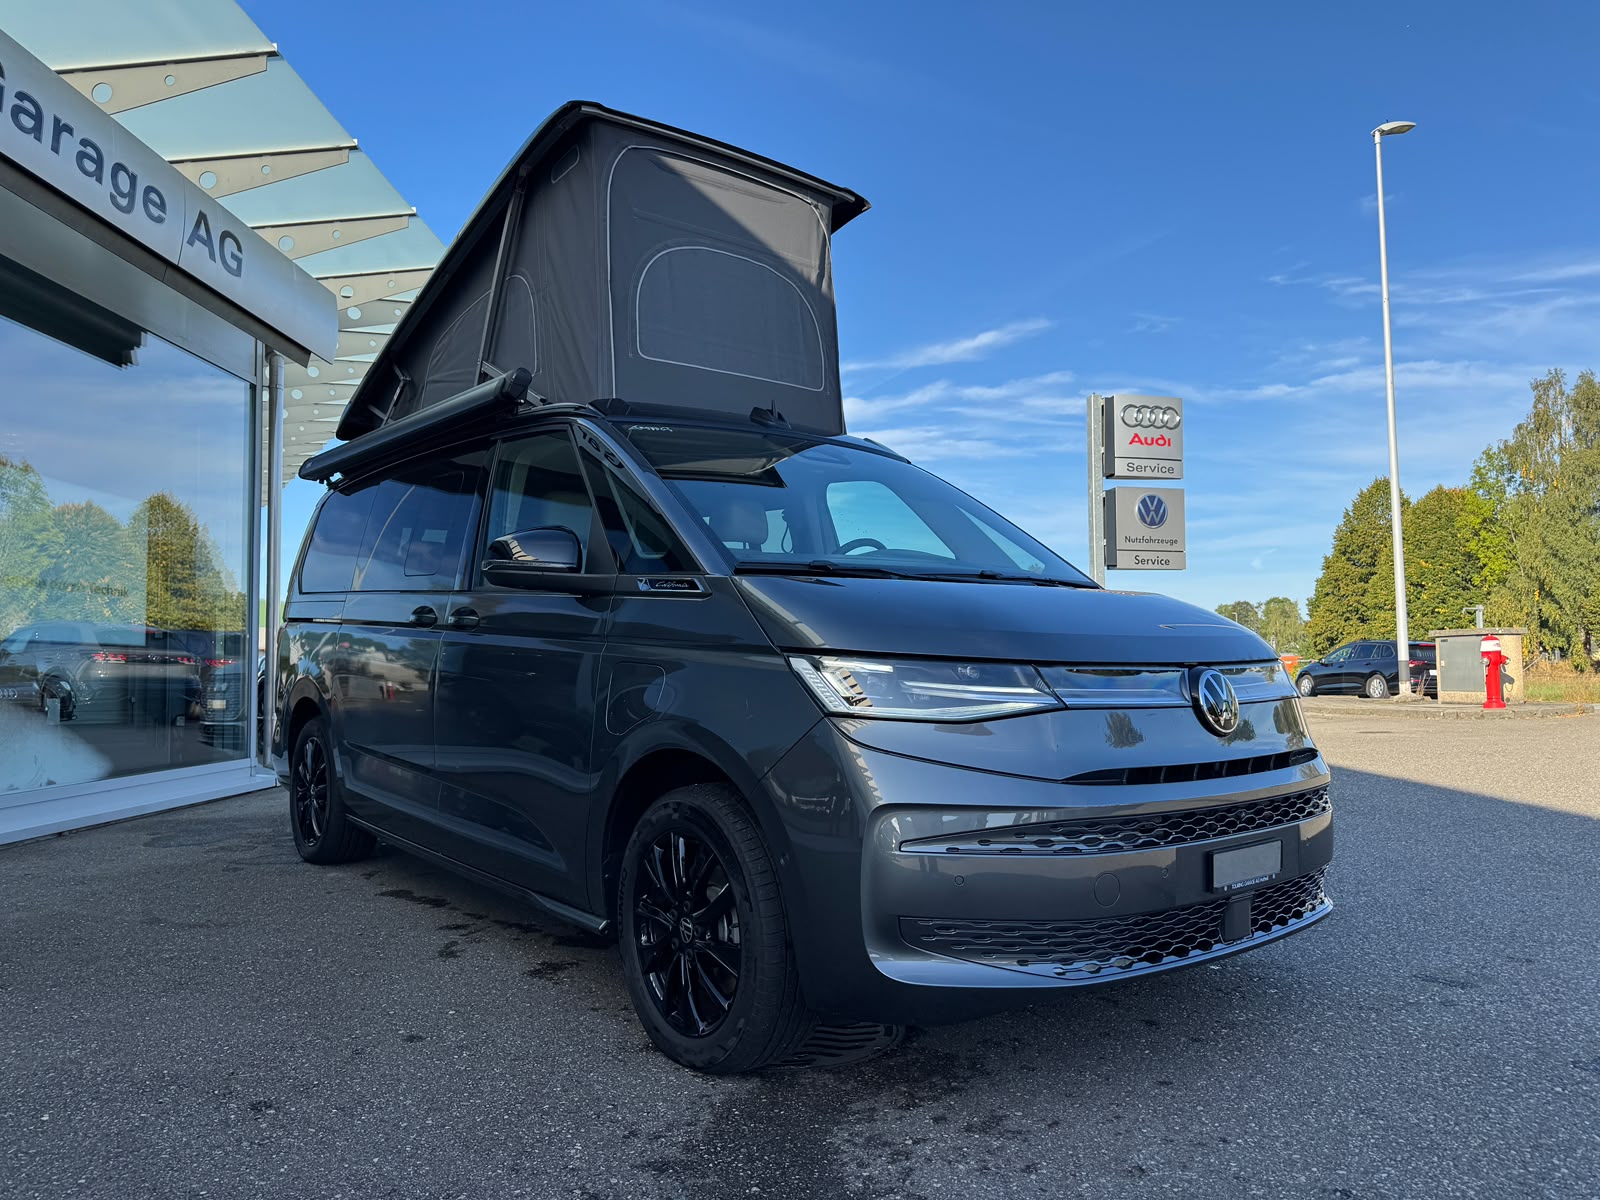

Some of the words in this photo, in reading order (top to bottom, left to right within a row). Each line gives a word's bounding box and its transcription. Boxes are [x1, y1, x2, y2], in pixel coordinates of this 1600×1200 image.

[186, 209, 243, 278] AG
[1128, 432, 1172, 447] Audi
[1126, 462, 1175, 475] Service
[1124, 535, 1179, 547] Nutzfahrzeuge
[1134, 554, 1170, 566] Service
